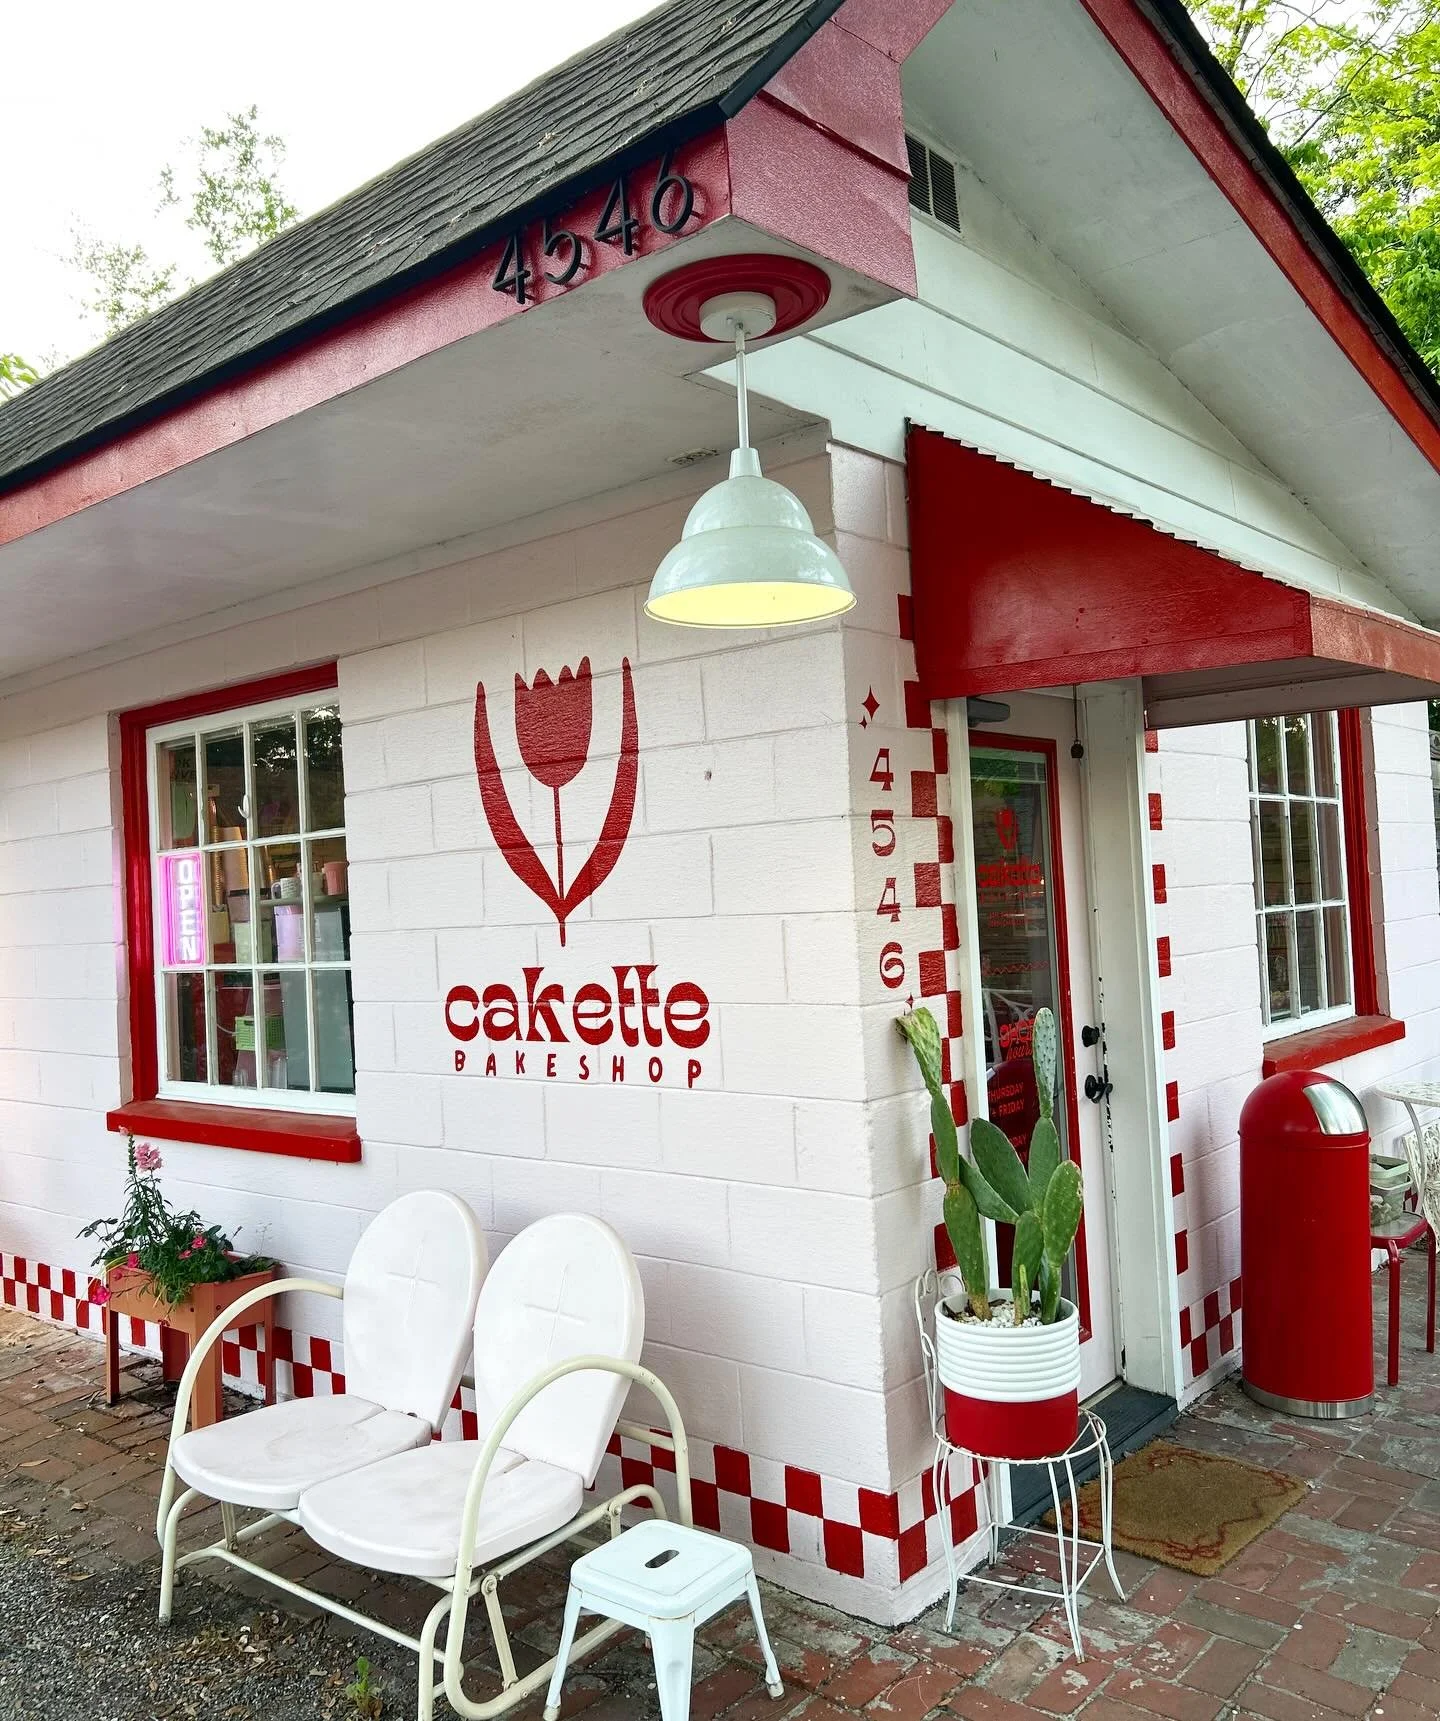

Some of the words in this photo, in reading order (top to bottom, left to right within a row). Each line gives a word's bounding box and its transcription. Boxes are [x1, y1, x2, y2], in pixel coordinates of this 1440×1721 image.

[492, 153, 694, 304] 4546
[178, 860, 197, 961] OPEN
[445, 964, 711, 1049] cakette
[455, 1050, 702, 1089] BAKESHOP
[999, 1099, 1025, 1117] FRIDAY
